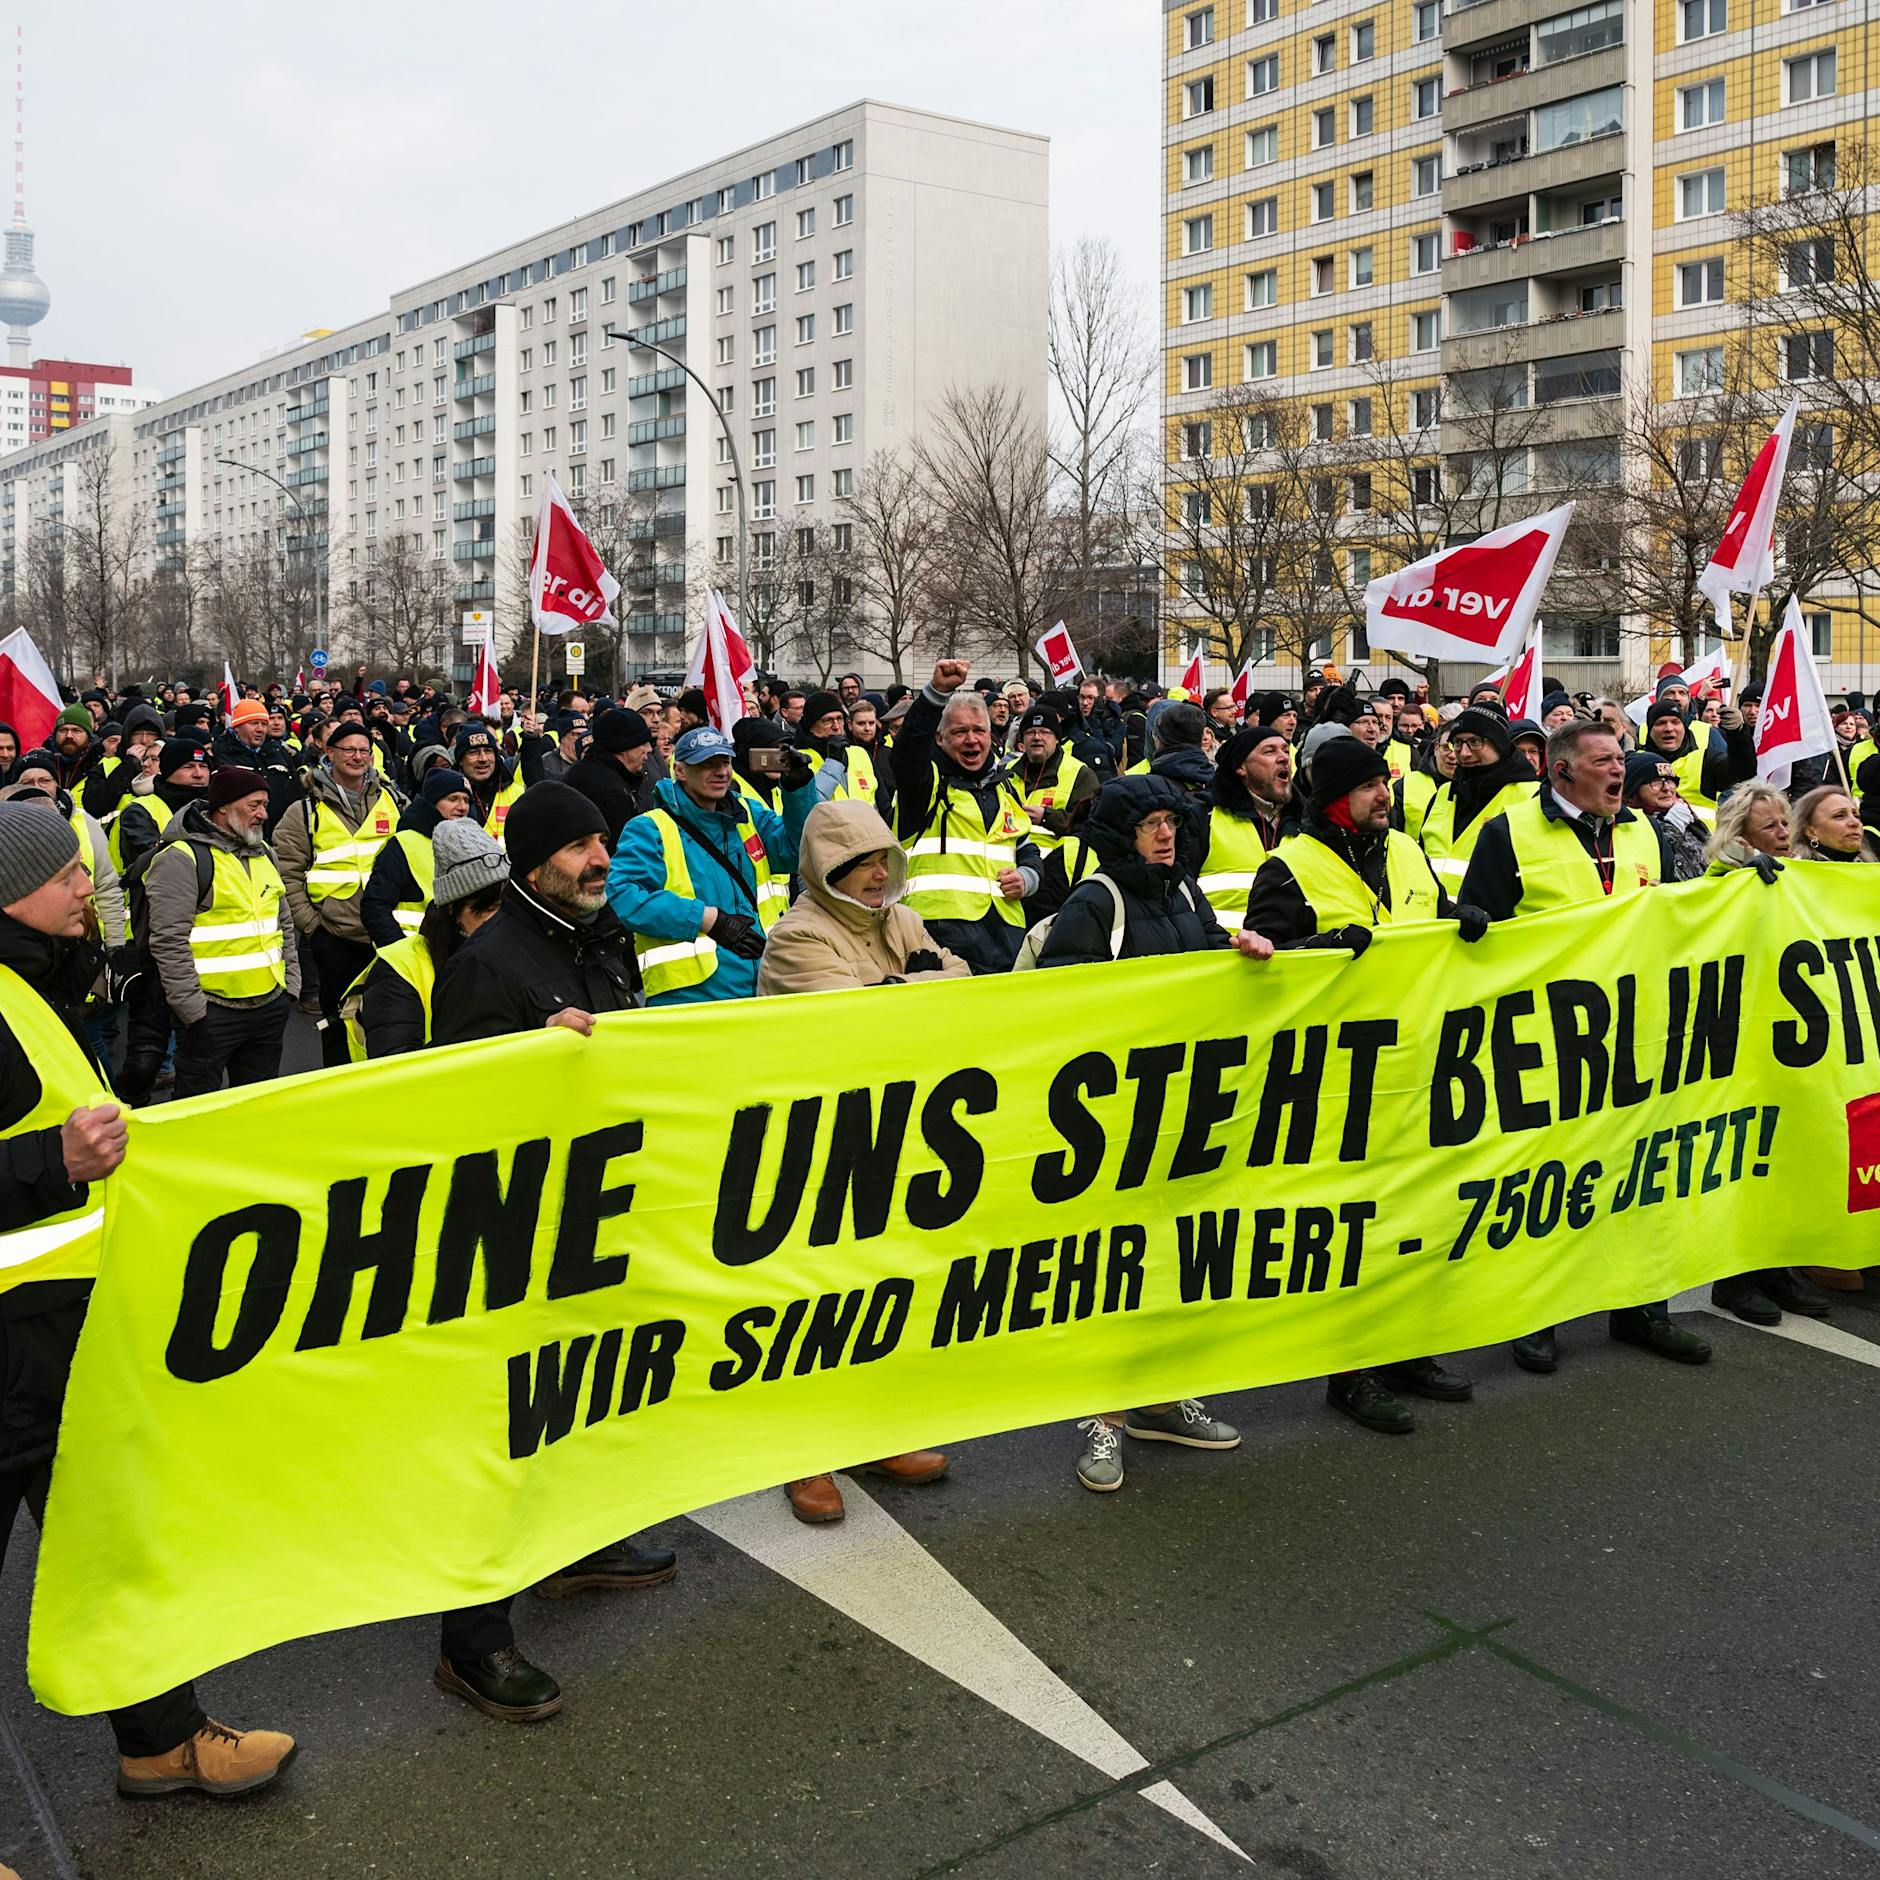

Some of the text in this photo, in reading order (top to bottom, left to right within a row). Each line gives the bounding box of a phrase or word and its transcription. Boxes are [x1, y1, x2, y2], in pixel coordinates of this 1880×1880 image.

[543, 570, 603, 617] er.di
[165, 936, 1880, 1383] OHNE UNS STEHT BERLIN STI
[508, 1106, 1780, 1459] WIR SIND MEHR WERT - 750€ JETZT!
